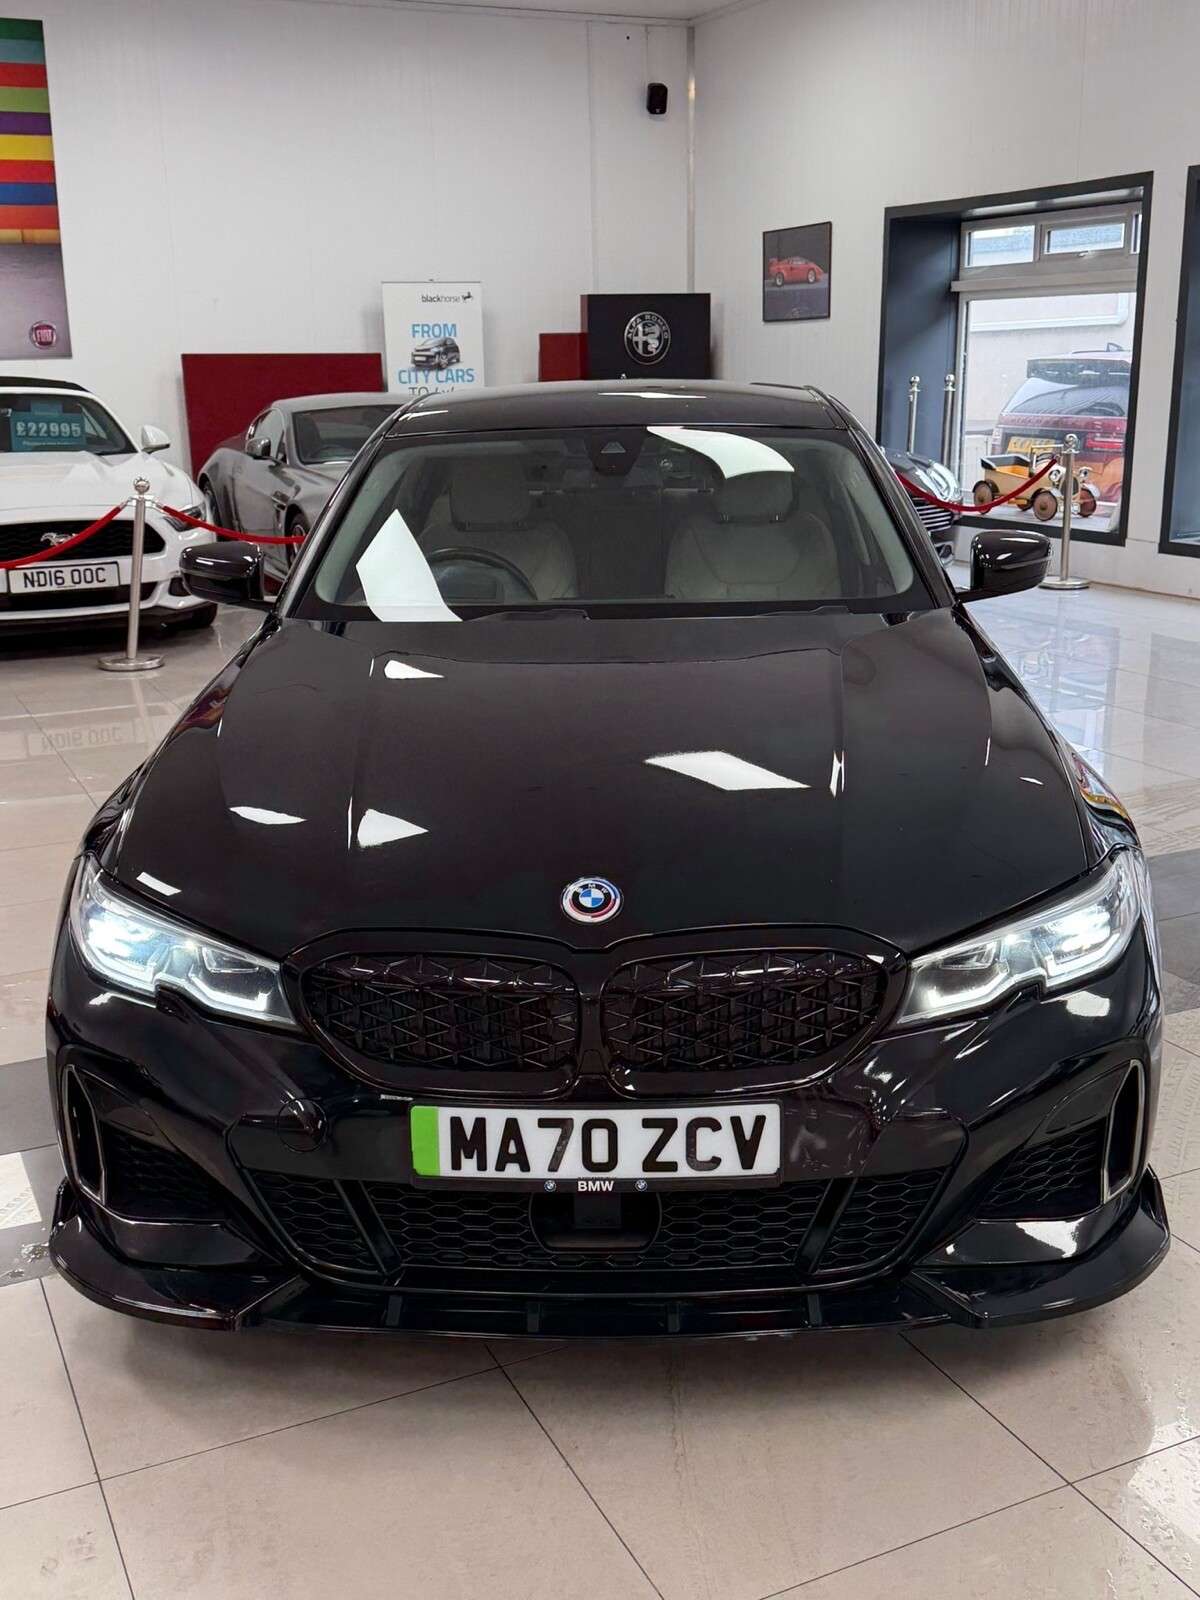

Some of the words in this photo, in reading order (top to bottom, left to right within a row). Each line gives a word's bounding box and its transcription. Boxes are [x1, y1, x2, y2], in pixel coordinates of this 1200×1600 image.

[411, 323, 457, 339] FROM
[627, 317, 642, 339] ALFA
[644, 314, 669, 339] ROMEO
[398, 368, 431, 385] CITY
[435, 368, 475, 383] CARS
[16, 422, 81, 437] £22995
[23, 569, 65, 588] ND16
[449, 1116, 618, 1173] MA70
[641, 1114, 766, 1173] ZCV
[577, 1180, 615, 1192] BMW
